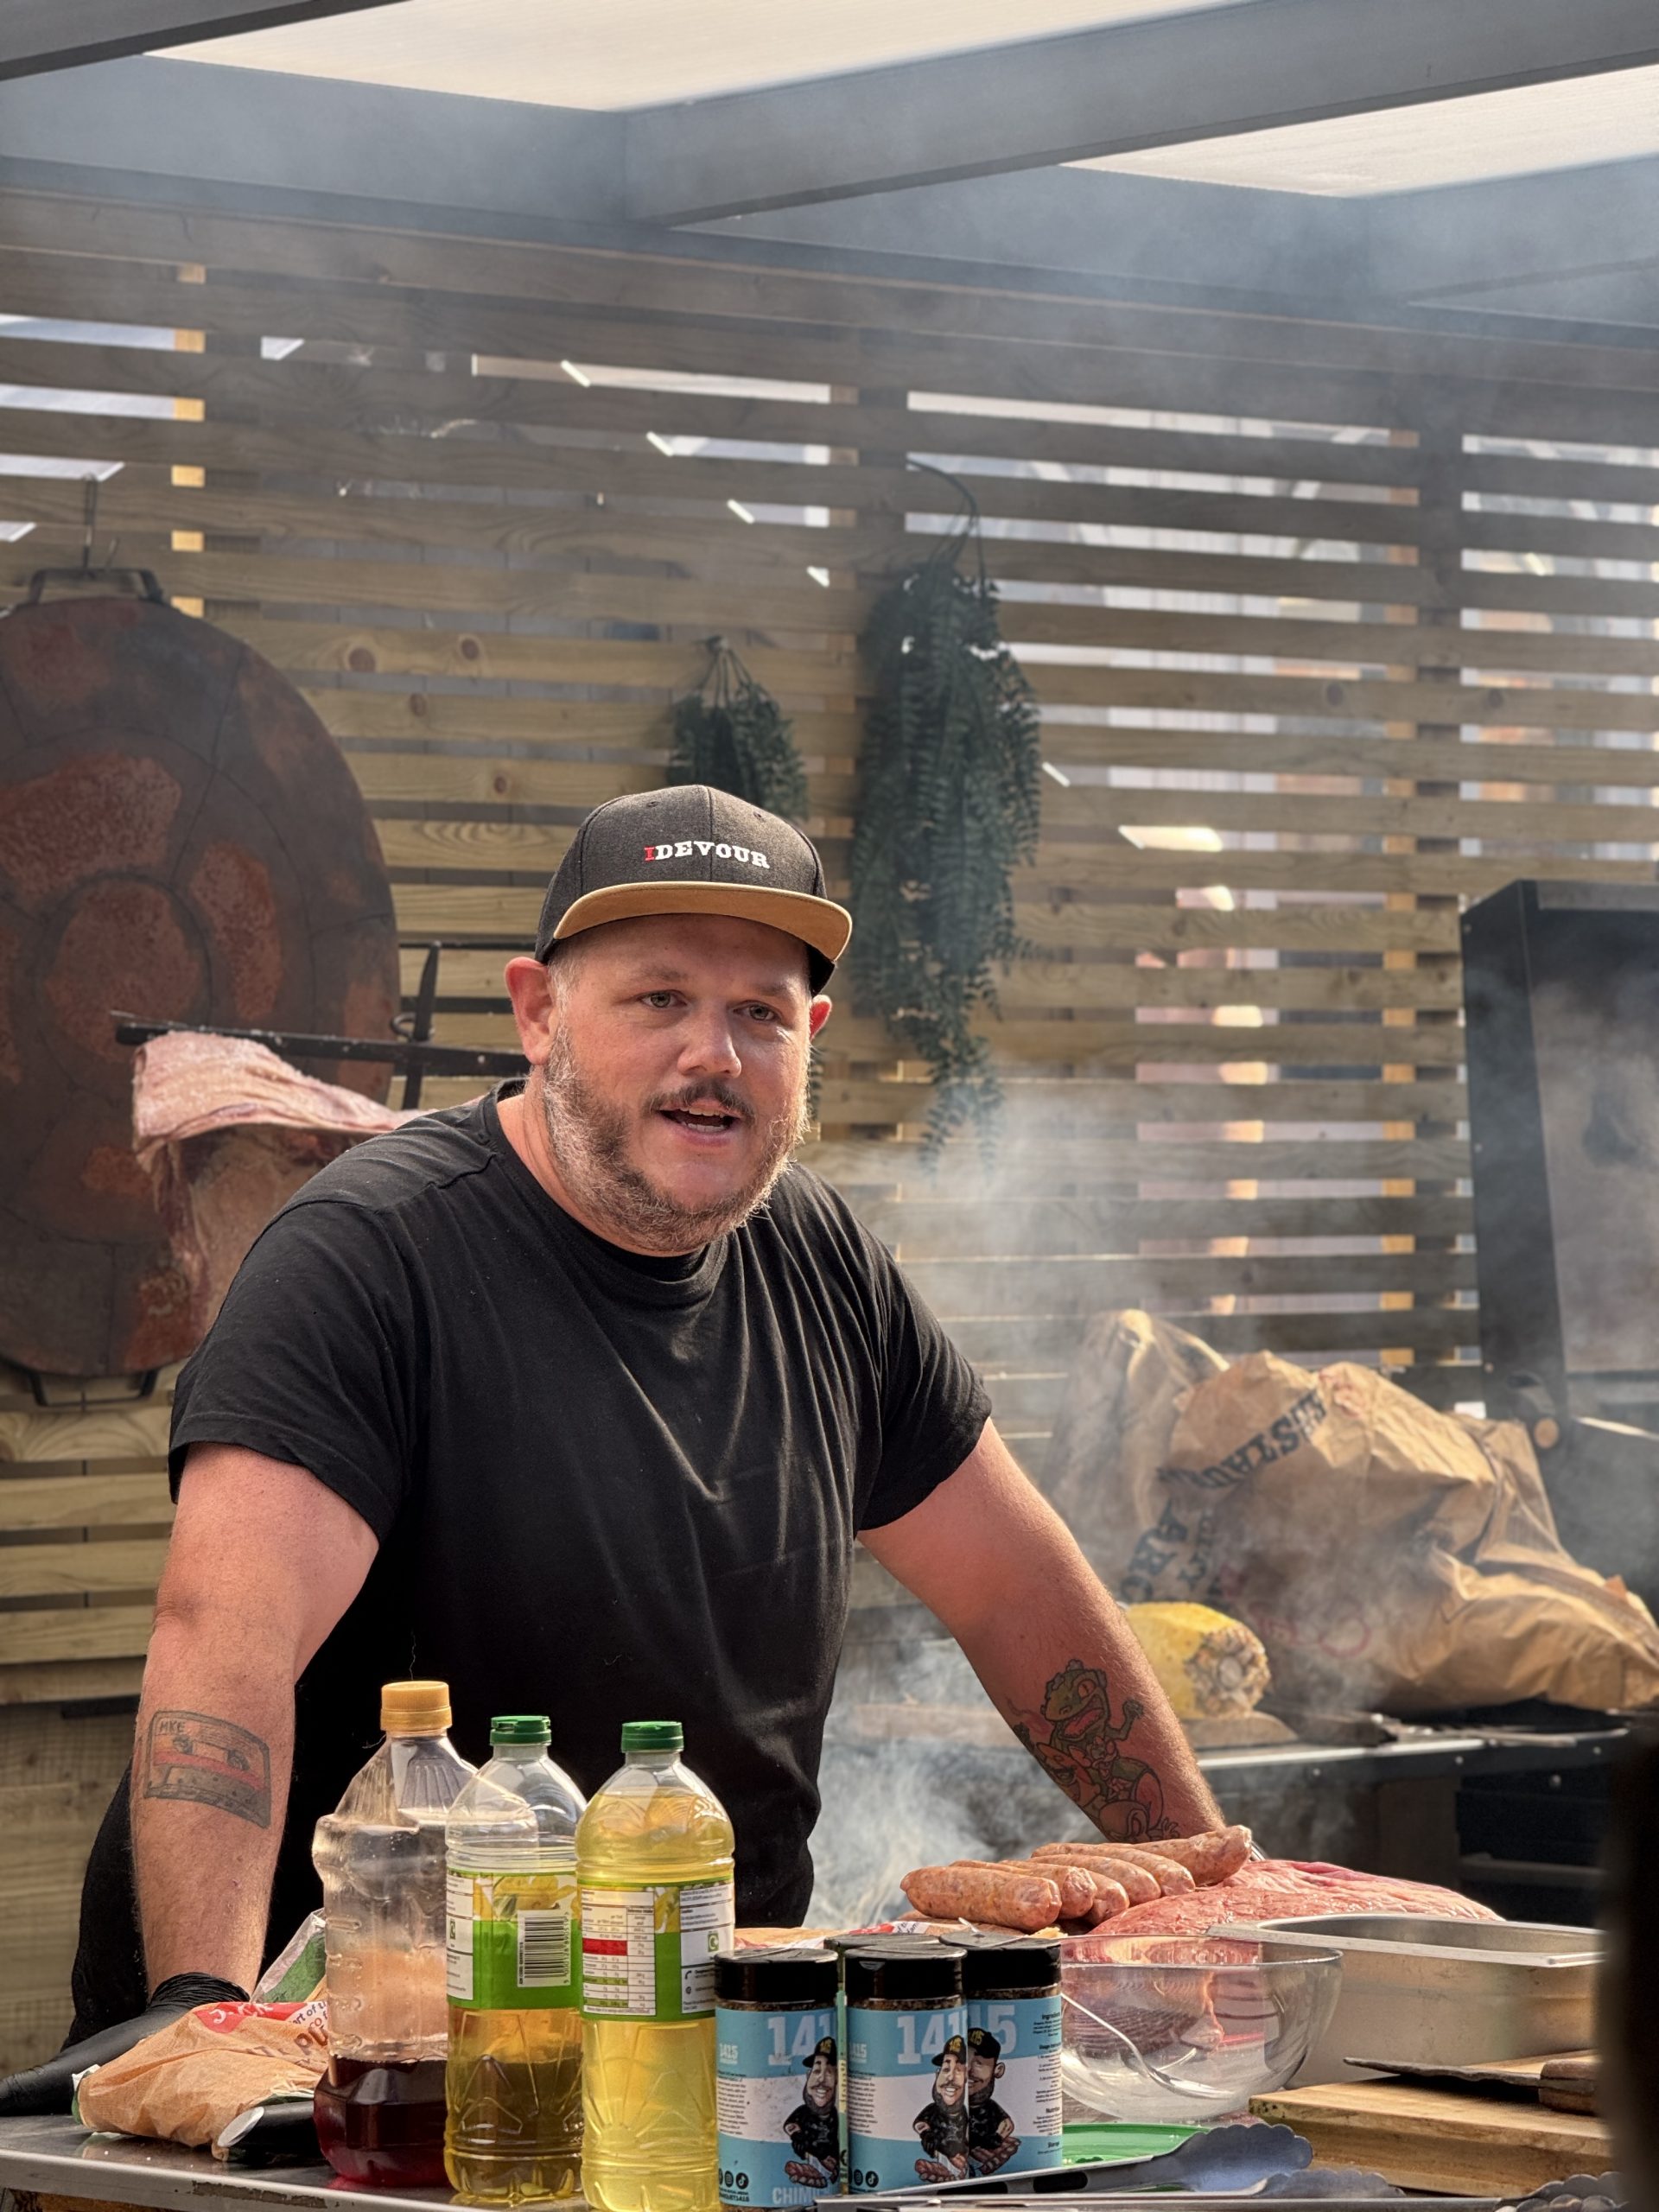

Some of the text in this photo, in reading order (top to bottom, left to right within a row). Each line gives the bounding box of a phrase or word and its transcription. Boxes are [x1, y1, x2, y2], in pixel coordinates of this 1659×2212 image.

[306, 2004, 316, 2016] of
[767, 2013, 834, 2066] 141
[897, 2010, 967, 2064] 141
